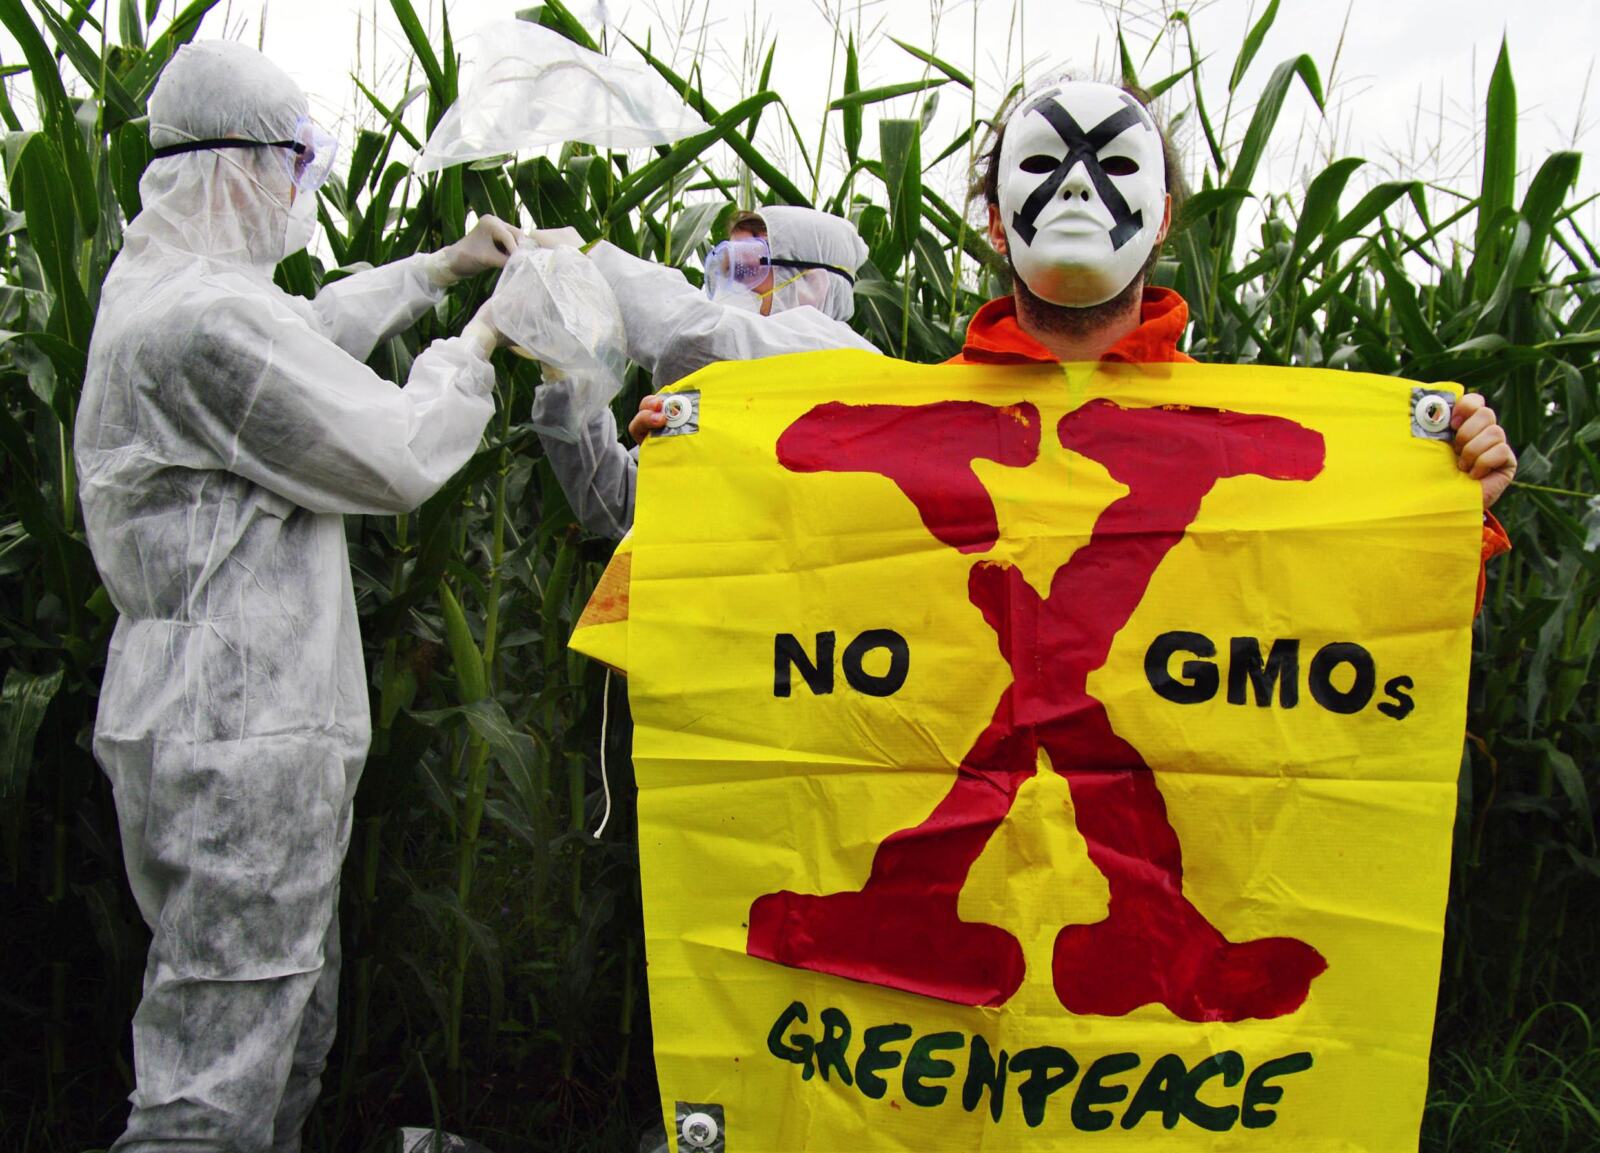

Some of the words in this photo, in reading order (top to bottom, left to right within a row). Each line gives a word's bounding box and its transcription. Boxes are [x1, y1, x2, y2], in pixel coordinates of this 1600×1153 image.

[774, 629, 909, 698] NO
[1144, 631, 1415, 721] GMOs
[767, 1001, 1313, 1132] GREENPEACE
